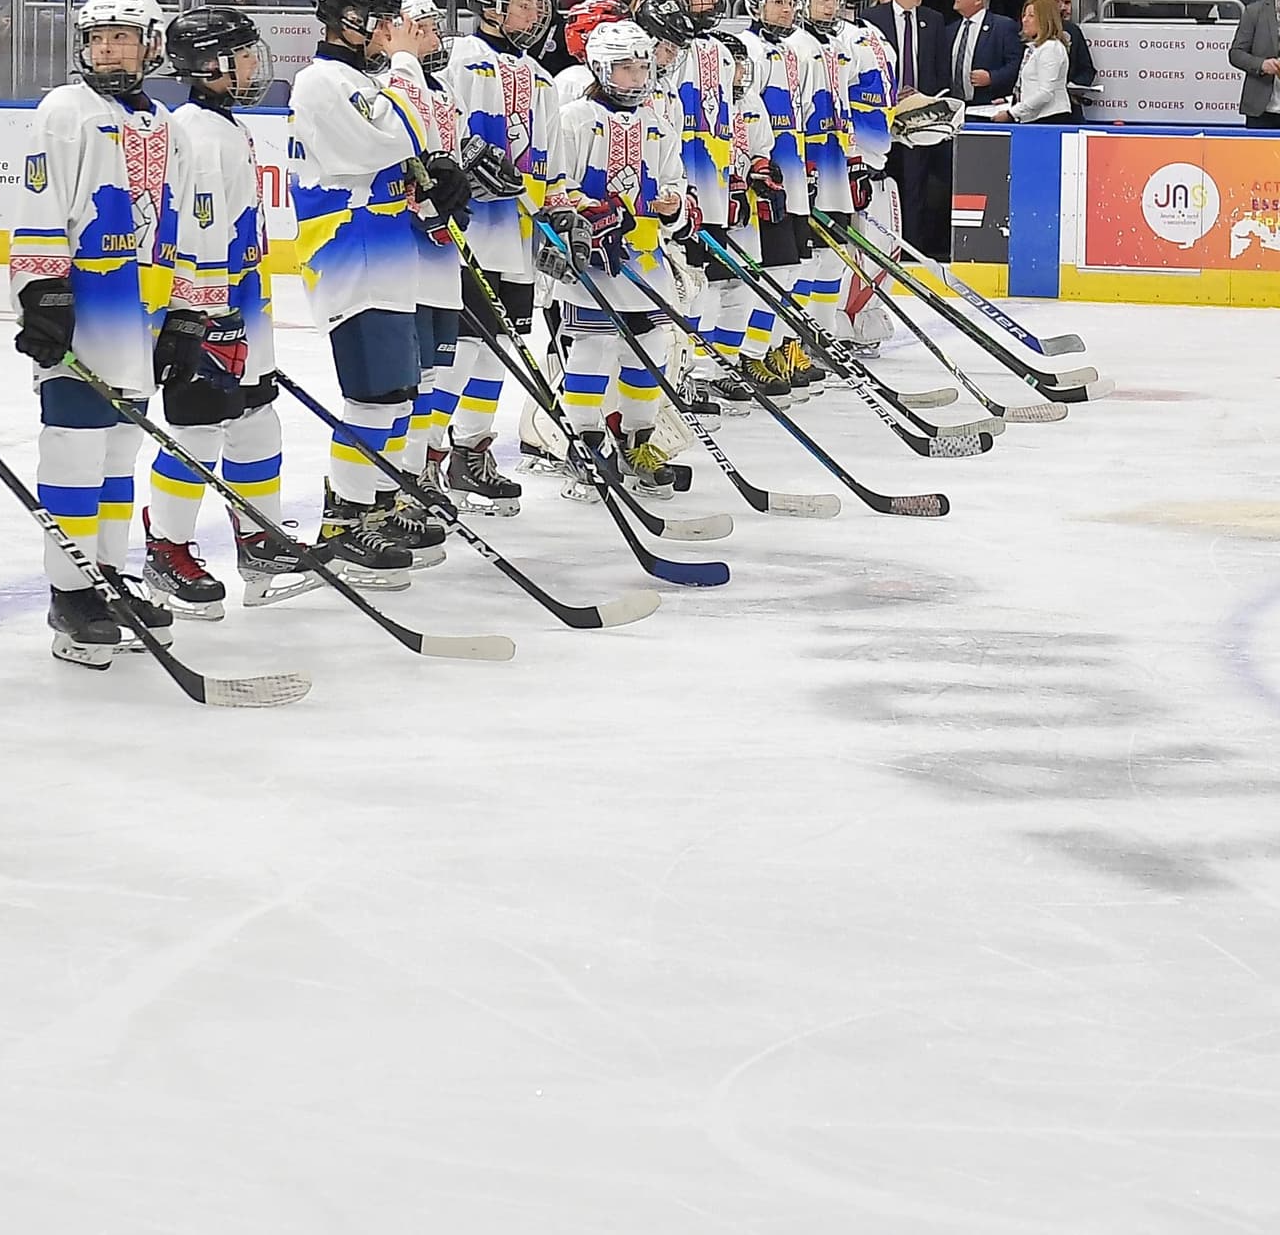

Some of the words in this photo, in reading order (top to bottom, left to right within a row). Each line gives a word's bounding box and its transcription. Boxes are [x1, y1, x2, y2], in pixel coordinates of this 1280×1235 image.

[280, 27, 311, 35] ROGERS
[1094, 39, 1129, 48] ROGERS
[1150, 41, 1186, 50] ROGERS
[280, 55, 311, 63] ROGERS
[1099, 70, 1129, 79] OGERS
[1149, 71, 1186, 80] ROGERS
[1205, 72, 1242, 81] ROGERS
[1149, 102, 1185, 111] ROGERS
[1154, 183, 1209, 210] JAS
